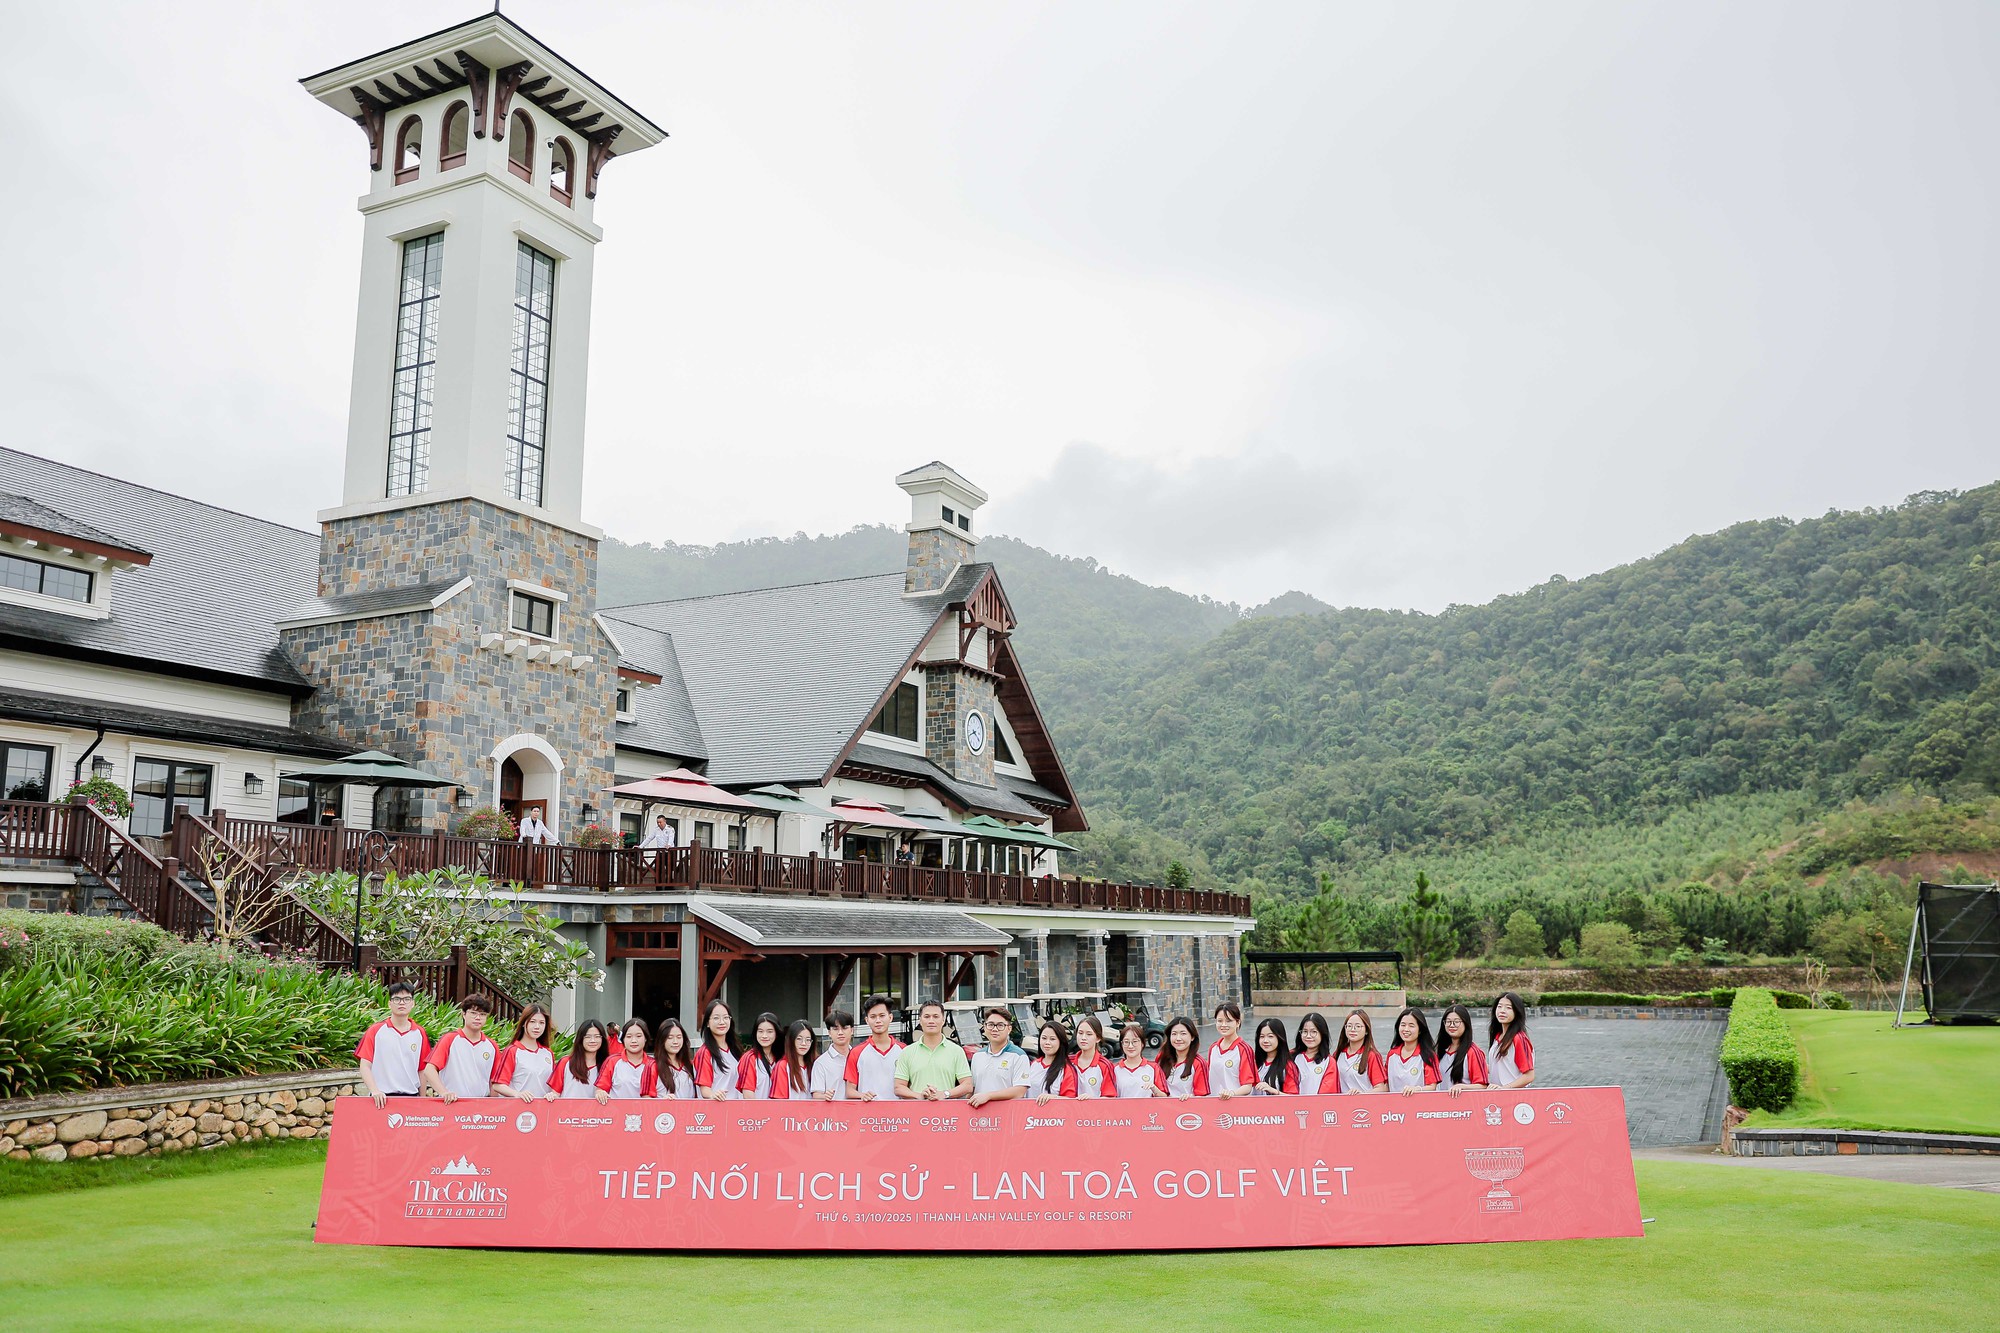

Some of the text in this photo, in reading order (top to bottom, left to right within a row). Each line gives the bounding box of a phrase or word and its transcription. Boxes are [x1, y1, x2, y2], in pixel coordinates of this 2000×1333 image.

[454, 1115, 506, 1123] VGA TOUR
[581, 1117, 613, 1125] HONG
[737, 1118, 769, 1126] GOLF
[860, 1117, 910, 1125] GOLFMAN
[919, 1117, 959, 1126] GOLF
[1233, 1115, 1285, 1125] HUNGANH
[1381, 1111, 1405, 1124] play
[1024, 1116, 1065, 1130] SRIXON
[1076, 1119, 1132, 1127] COLE HAAN
[430, 1167, 491, 1176] 20 25
[598, 1162, 676, 1199] TIẾP
[691, 1163, 759, 1200] NỐI
[775, 1171, 861, 1209] LỊCH
[877, 1164, 930, 1201] SỬ
[972, 1170, 1045, 1200] LAN
[1061, 1162, 1138, 1199] TOẢ
[1153, 1169, 1257, 1198] GOLF
[1271, 1159, 1354, 1204] VIỆT
[409, 1180, 508, 1202] TheGolfers
[408, 1204, 504, 1217] Tournament
[815, 1211, 838, 1222] THỨ
[842, 1212, 851, 1223] 6,
[854, 1212, 912, 1223] 31/10/2025
[923, 1212, 961, 1222] THANH
[965, 1212, 996, 1222] LANH
[999, 1211, 1040, 1222] VALLEY
[1044, 1211, 1074, 1221] GOLF
[1078, 1211, 1086, 1221] &
[1089, 1211, 1133, 1221] RESORT
